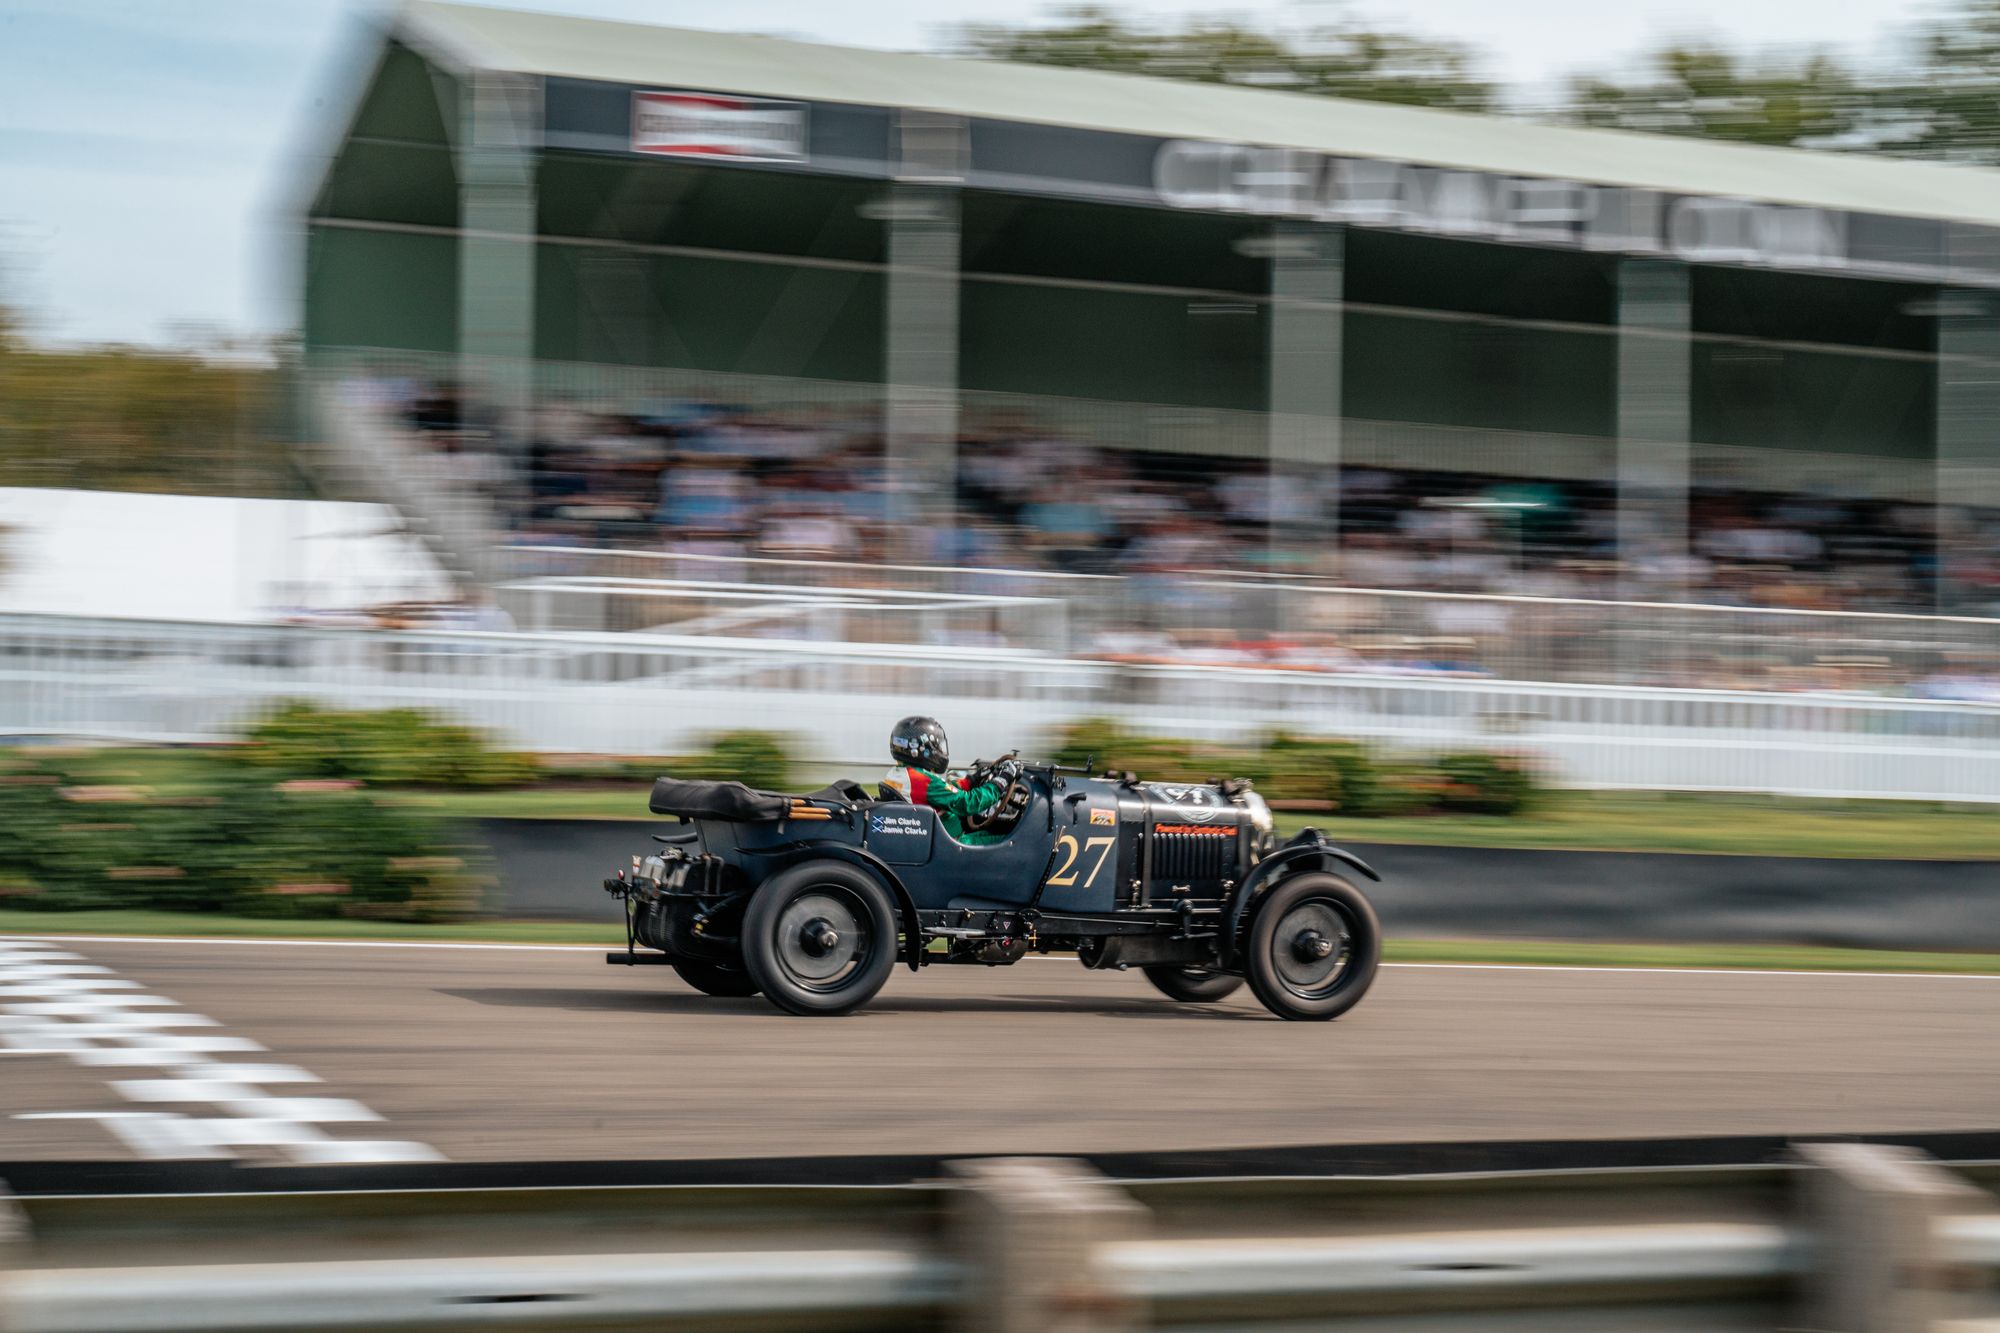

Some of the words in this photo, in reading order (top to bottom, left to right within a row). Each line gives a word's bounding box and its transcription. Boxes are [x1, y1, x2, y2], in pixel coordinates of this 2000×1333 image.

[884, 817, 897, 825] Jim
[898, 817, 921, 826] Clarke
[882, 826, 904, 834] Jamie
[904, 827, 928, 835] Clarke
[1045, 835, 1115, 888] 27
